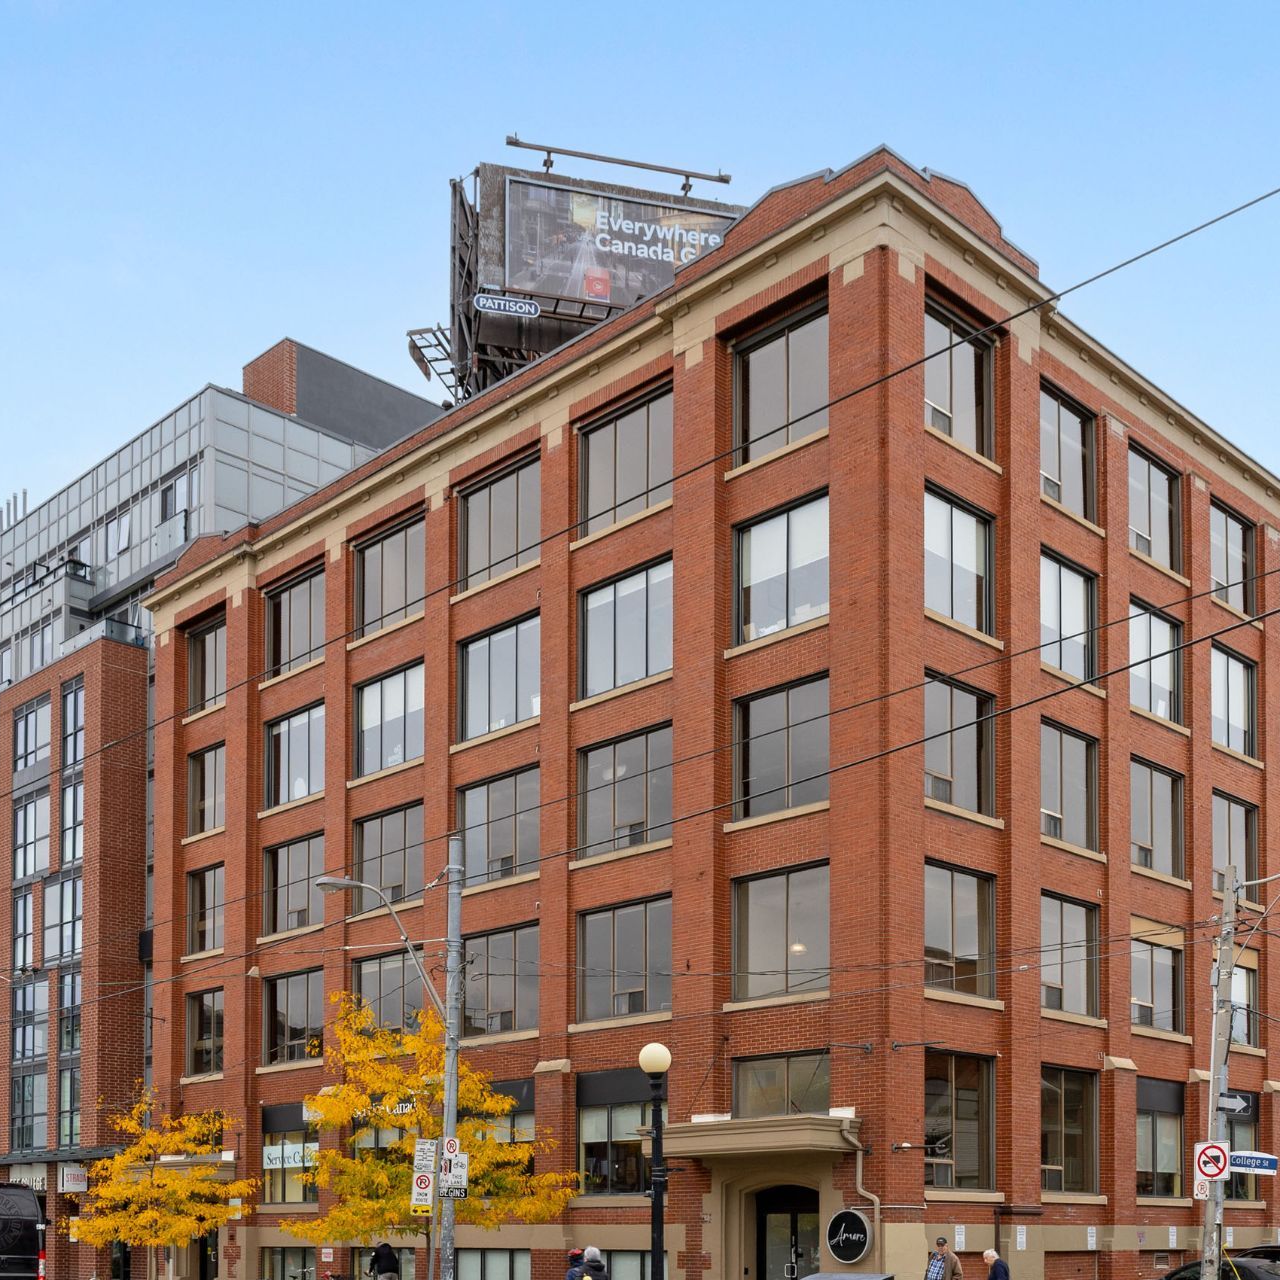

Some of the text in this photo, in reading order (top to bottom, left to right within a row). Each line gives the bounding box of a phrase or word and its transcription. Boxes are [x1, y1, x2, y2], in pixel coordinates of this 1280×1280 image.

[595, 210, 721, 248] Everywhere
[594, 232, 675, 263] Canada
[478, 298, 536, 314] PATTISON
[1231, 1156, 1261, 1168] College
[439, 1188, 466, 1198] BEGINS
